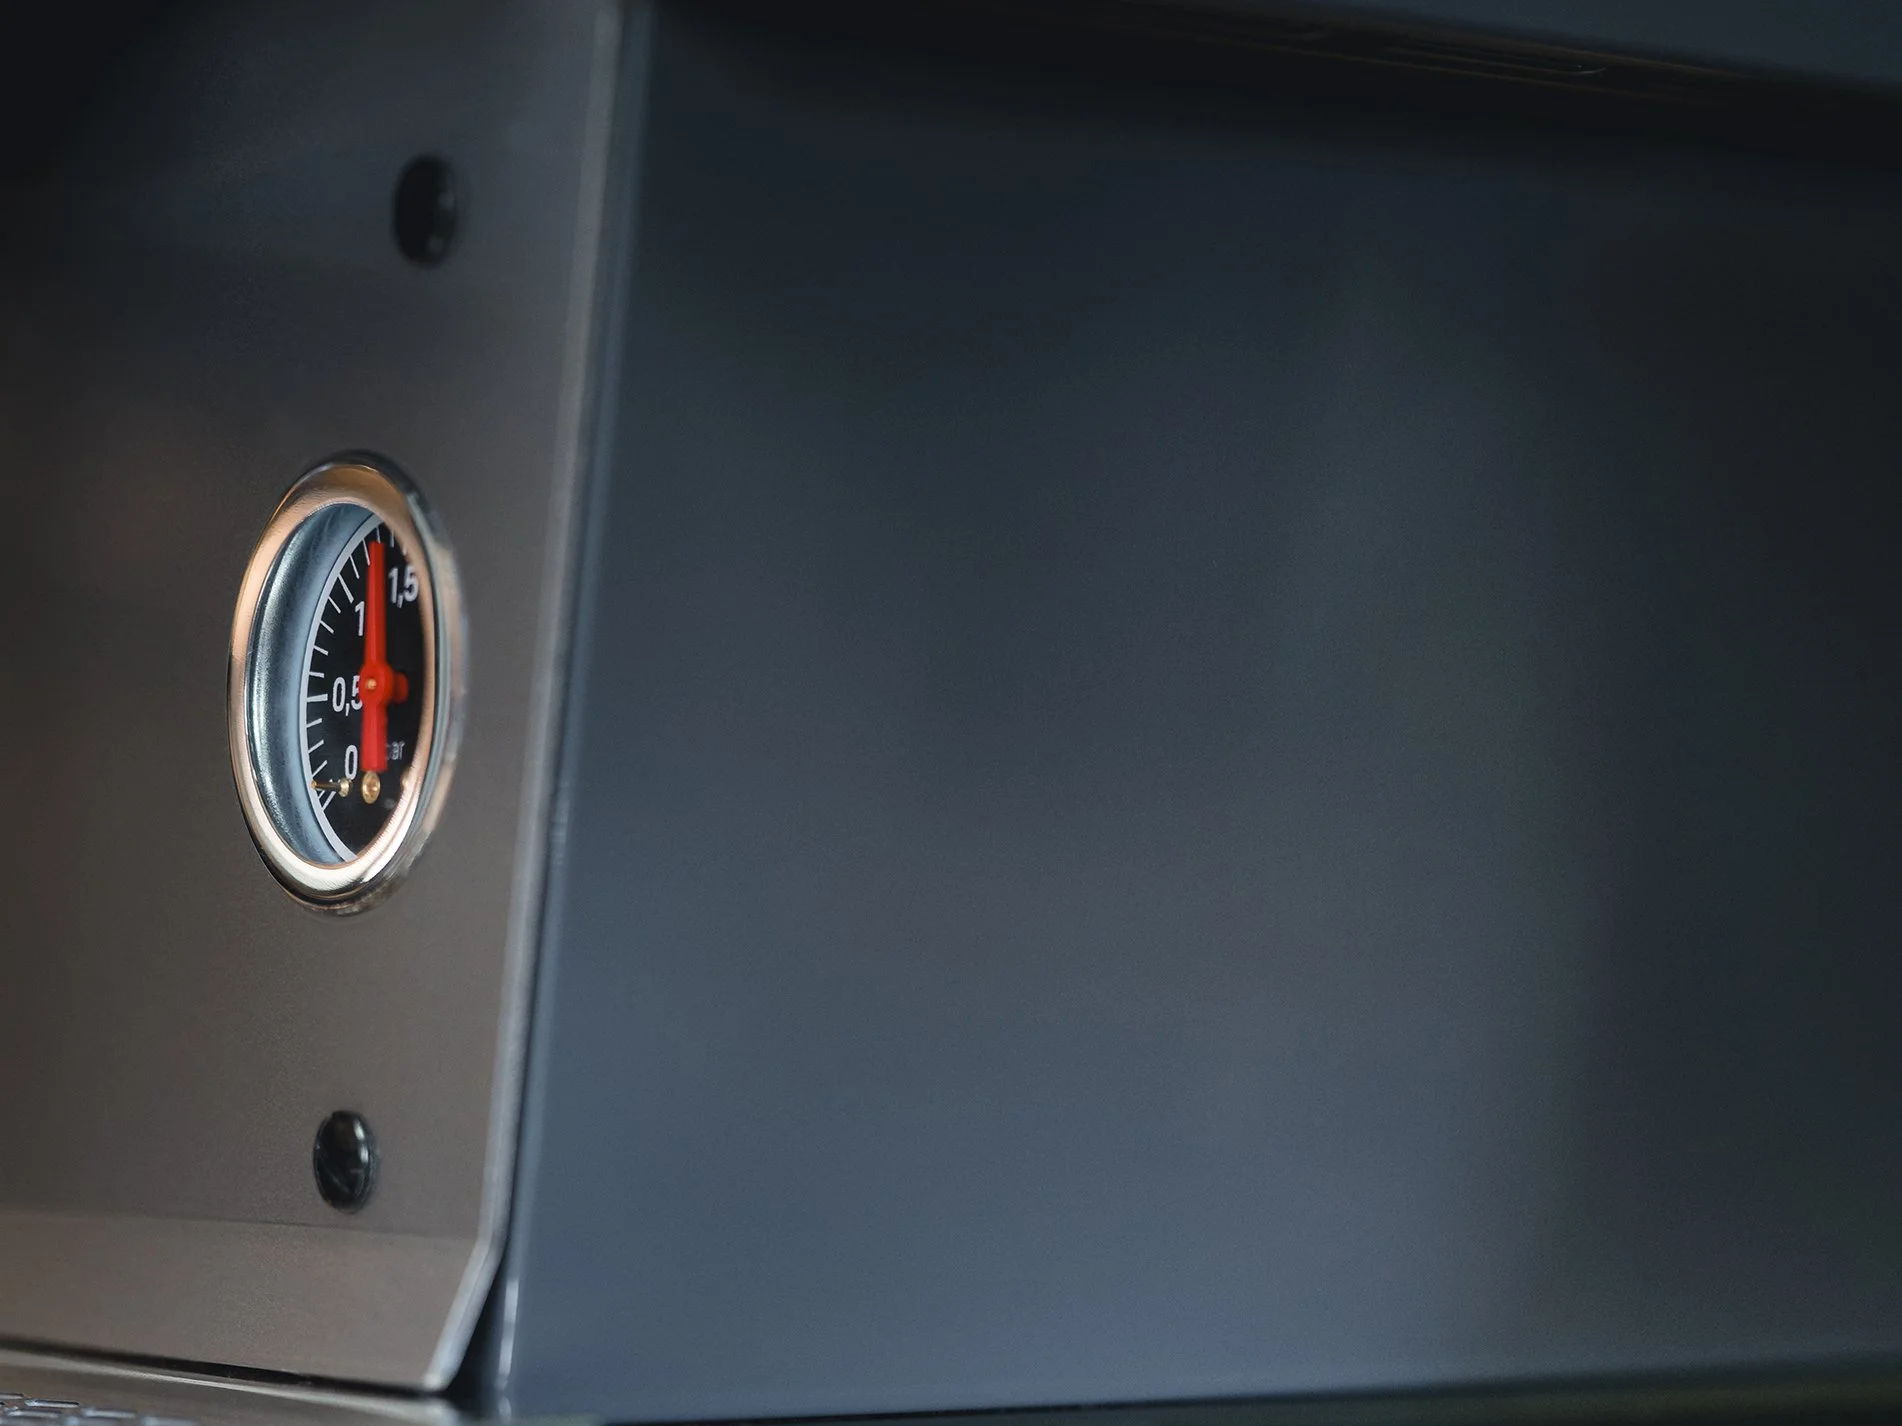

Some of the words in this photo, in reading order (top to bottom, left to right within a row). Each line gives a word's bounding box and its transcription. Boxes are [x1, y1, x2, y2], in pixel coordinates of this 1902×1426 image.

[388, 566, 419, 608] 1,5
[354, 601, 365, 636] 1
[332, 676, 363, 717] 0,5
[344, 744, 358, 780] 0
